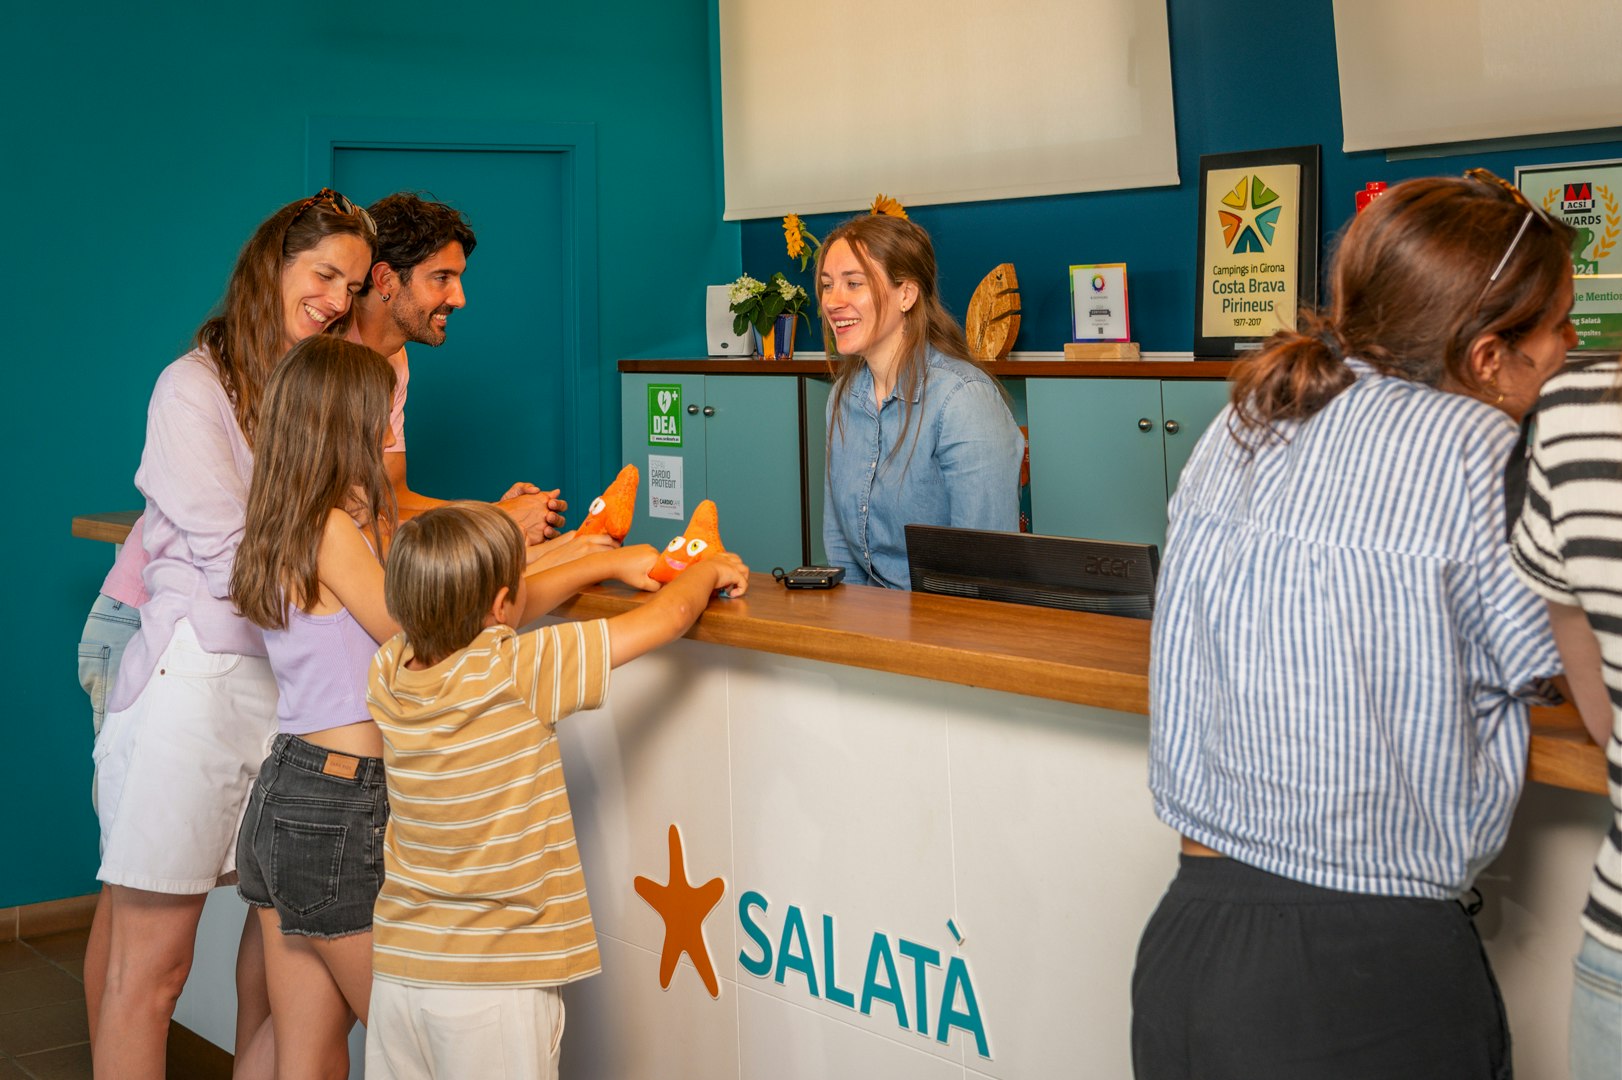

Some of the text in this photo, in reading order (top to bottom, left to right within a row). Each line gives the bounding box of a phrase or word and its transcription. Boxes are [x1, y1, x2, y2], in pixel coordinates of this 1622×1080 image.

[1567, 201, 1587, 209] ACSI
[1560, 215, 1602, 226] WARDS
[1213, 263, 1285, 277] Campings in Girona
[1212, 278, 1286, 294] Costa Brava
[1222, 297, 1274, 313] Pirineus
[1233, 317, 1262, 327] 1977-2017
[653, 415, 677, 434] DEA
[651, 469, 671, 479] CARDIO
[651, 478, 676, 489] PROTEGIT
[1085, 555, 1136, 577] acer
[738, 890, 992, 1059] SALATÀ
